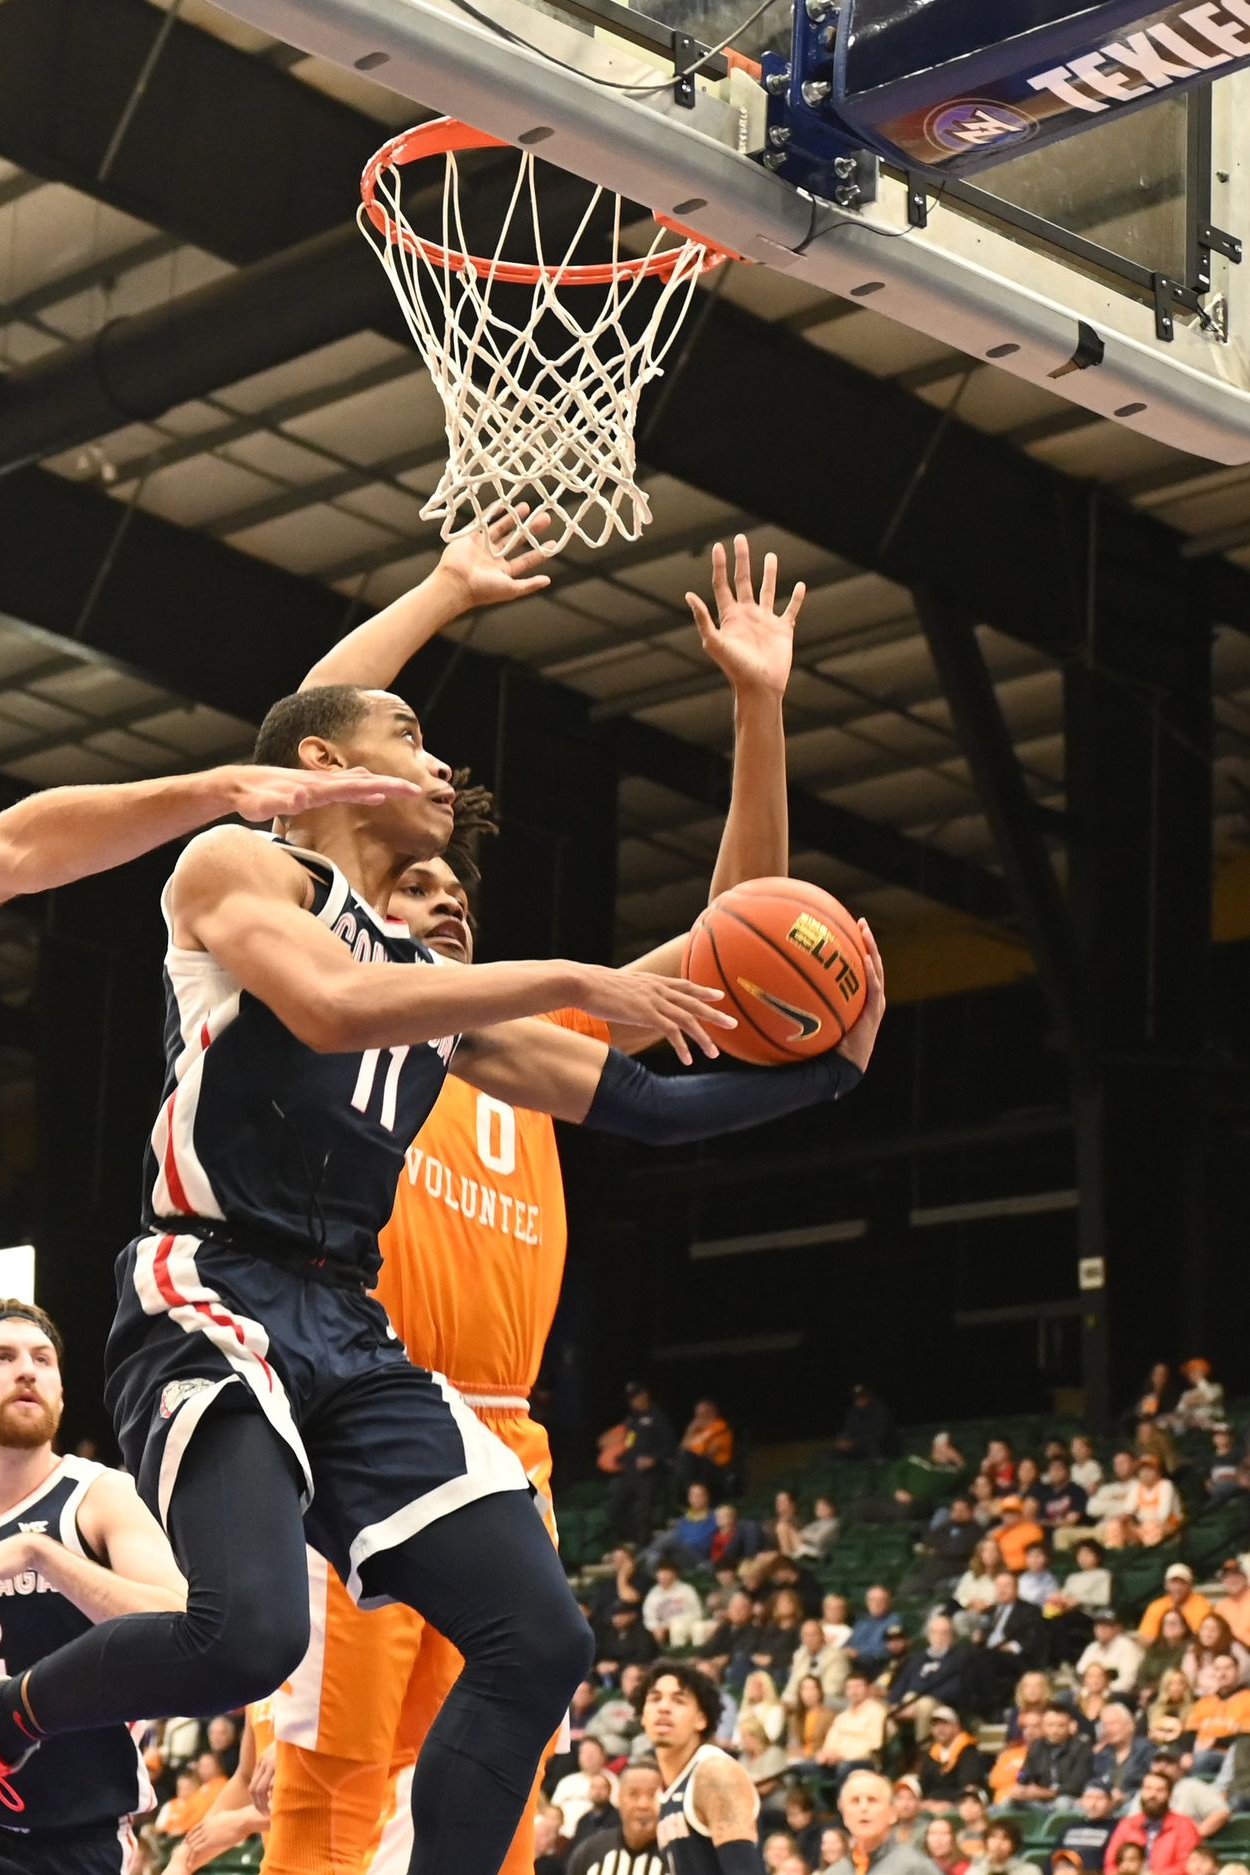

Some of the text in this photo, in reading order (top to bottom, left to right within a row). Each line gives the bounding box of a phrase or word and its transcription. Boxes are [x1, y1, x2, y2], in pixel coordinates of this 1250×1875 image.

[788, 928, 860, 1003] ELITE
[350, 1045, 410, 1133] 11
[476, 1092, 516, 1176] 0
[405, 1146, 543, 1246] VOLUNTEE
